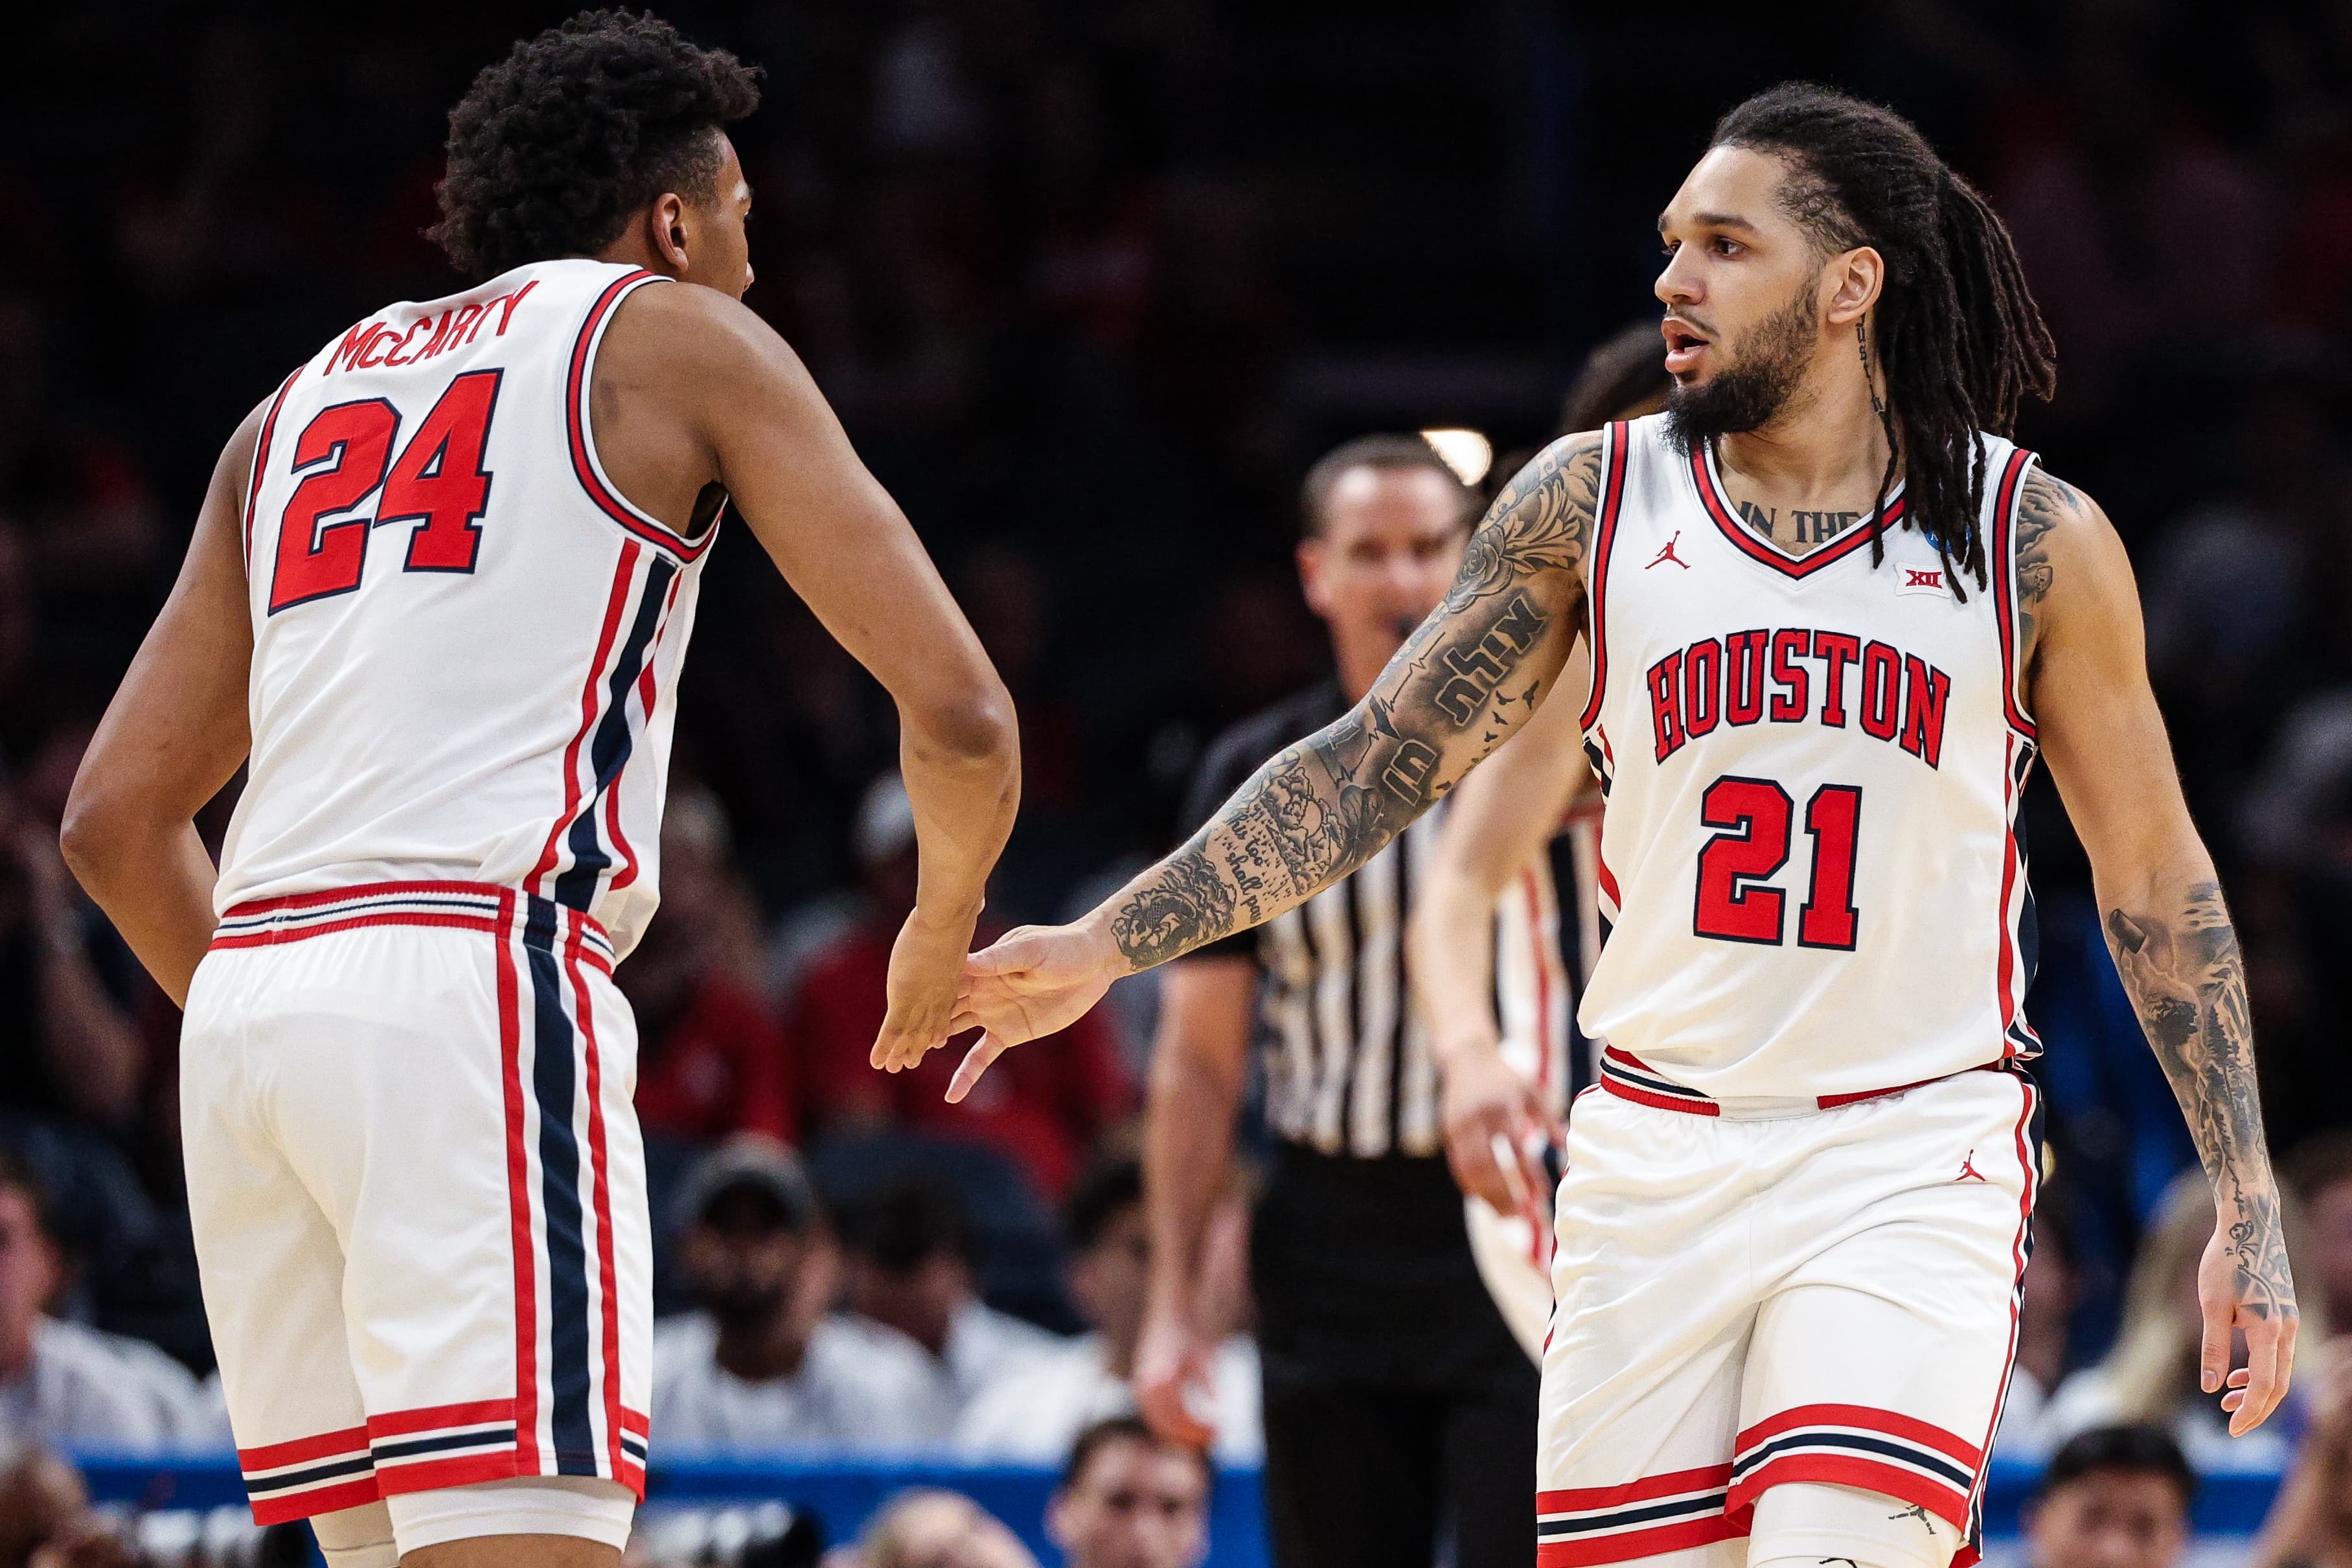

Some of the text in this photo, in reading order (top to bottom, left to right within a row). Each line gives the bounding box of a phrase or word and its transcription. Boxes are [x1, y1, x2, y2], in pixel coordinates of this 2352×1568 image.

[268, 367, 505, 617] 24
[1905, 569, 1943, 589] XII
[1647, 628, 1952, 771] HOUSTON
[1225, 852, 1263, 895] shall
[1245, 835, 1263, 867] too
[1693, 774, 1863, 952] 21
